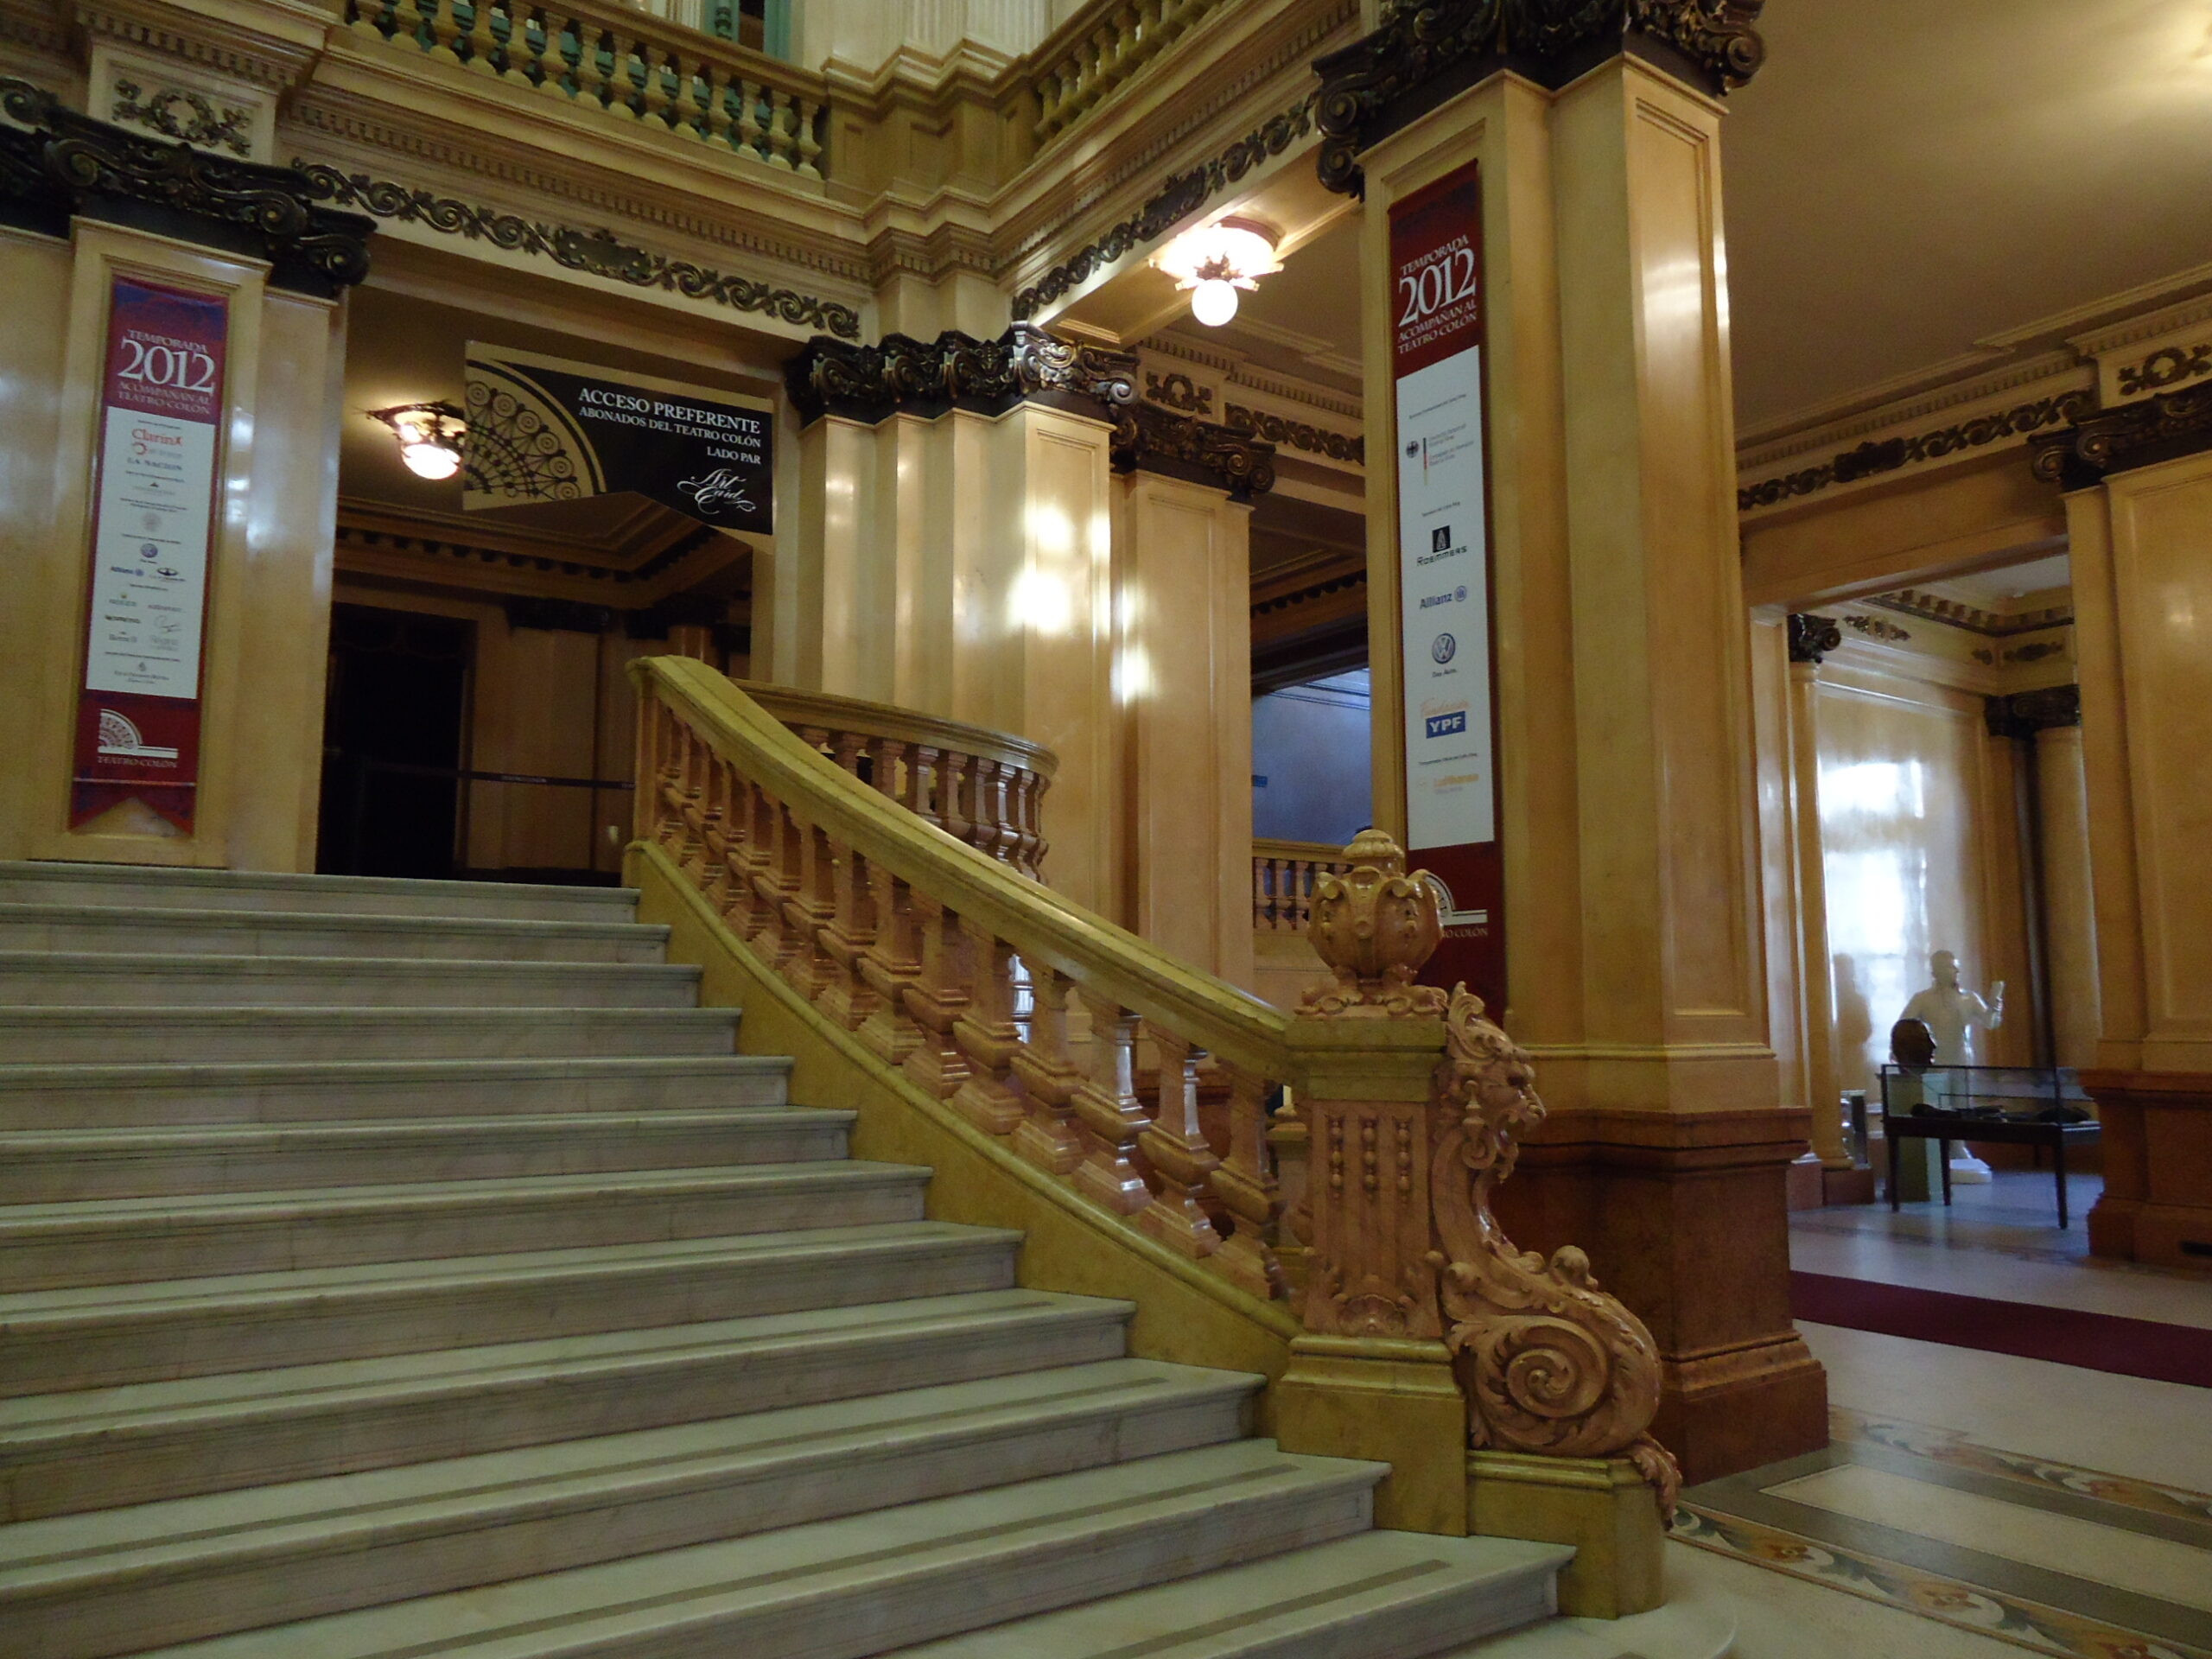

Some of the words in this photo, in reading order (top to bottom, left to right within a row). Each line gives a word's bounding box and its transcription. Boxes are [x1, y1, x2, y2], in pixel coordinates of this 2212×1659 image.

[1400, 234, 1469, 276] TEMPORADA
[1398, 248, 1477, 327] 2012
[127, 328, 207, 353] TEMPORADA
[1398, 330, 1438, 354] TEATRO
[118, 336, 215, 397] 2012
[118, 391, 167, 406] TEATRO
[578, 387, 650, 413] ACCESO
[654, 402, 761, 434] PREFERENTE
[579, 406, 646, 427] ABONADOS
[649, 418, 672, 432] DEL
[674, 423, 721, 441] TEATRO
[721, 432, 761, 448] COLÓN
[707, 446, 739, 461] LADO
[741, 453, 761, 465] PAR
[692, 468, 747, 489] Art
[1420, 593, 1452, 609] Allianz
[1429, 716, 1463, 733] YPF
